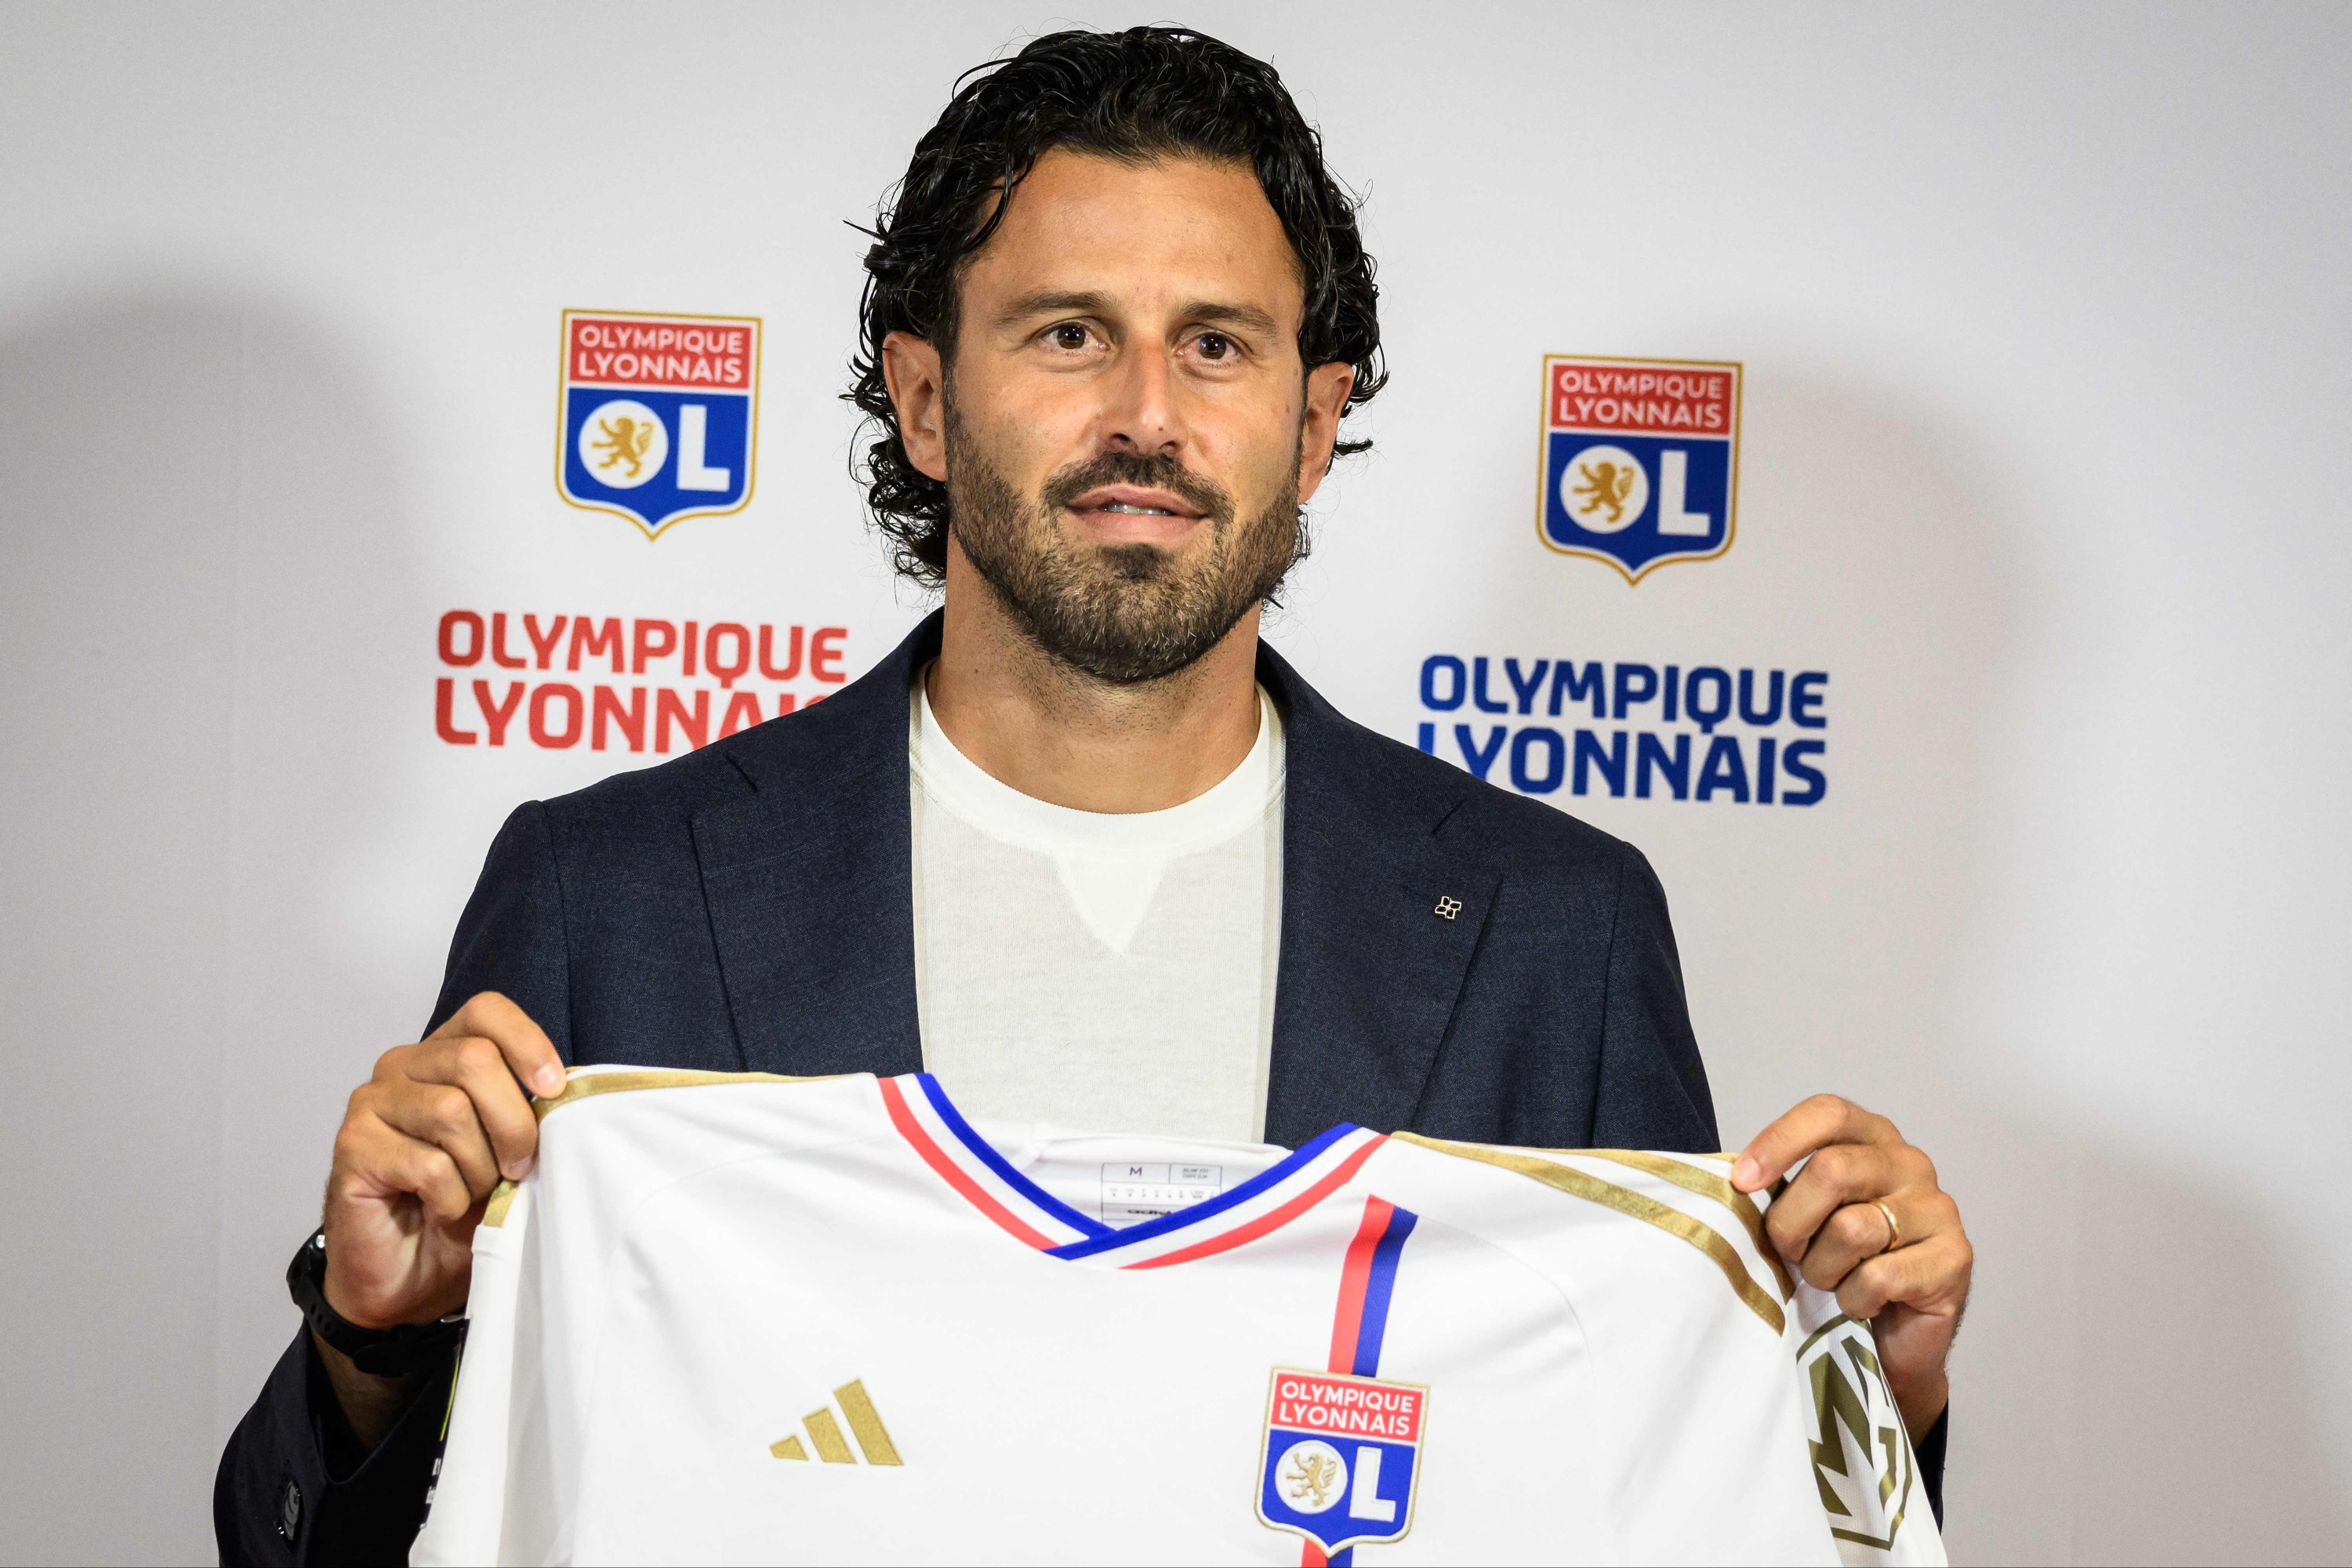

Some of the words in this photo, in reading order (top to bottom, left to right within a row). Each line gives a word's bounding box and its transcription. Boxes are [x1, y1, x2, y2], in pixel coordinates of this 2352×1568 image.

[578, 324, 744, 355] OLYMPIQUE
[577, 353, 742, 383] LYONNAIS
[1559, 369, 1724, 401] OLYMPIQUE
[1559, 397, 1723, 429] LYONNAIS
[437, 608, 849, 689] OLYMPIQUE
[1419, 654, 1829, 735] OLYMPIQUE
[434, 677, 833, 755] LYONNA
[1129, 1167, 1142, 1176] M
[1280, 1381, 1414, 1414] OLYMPIQUE
[1279, 1401, 1410, 1436] LYONNAIS
